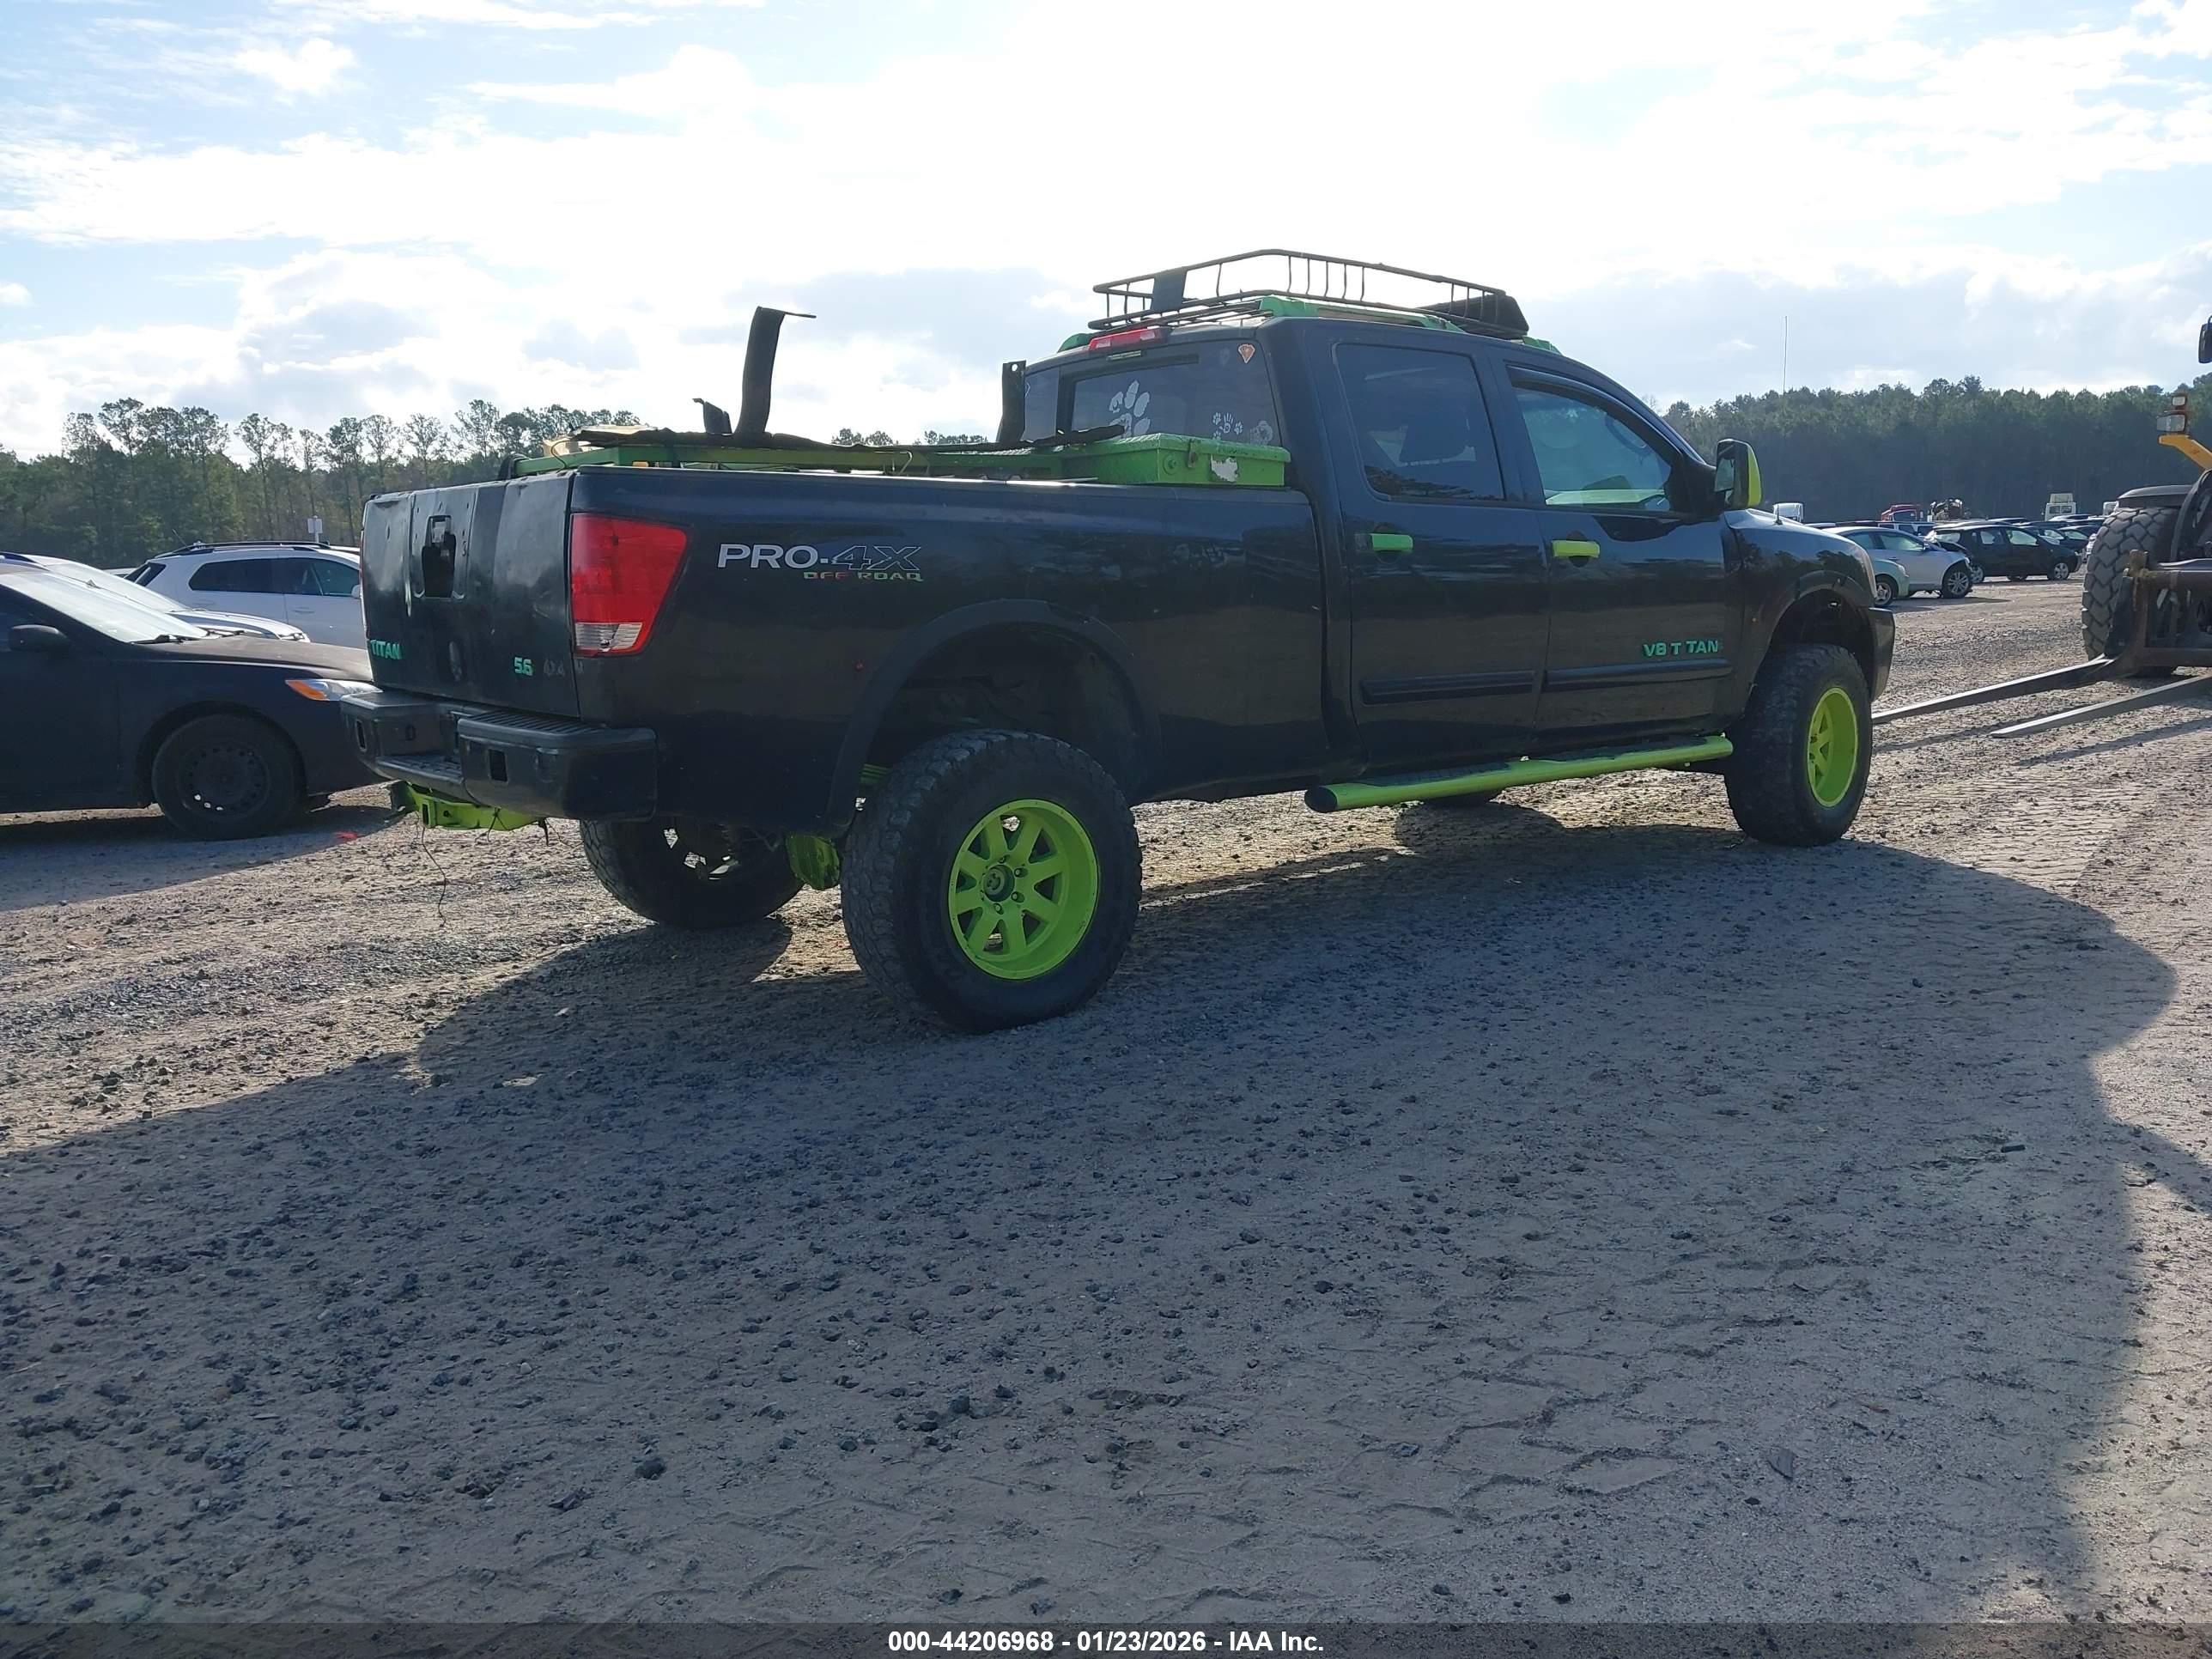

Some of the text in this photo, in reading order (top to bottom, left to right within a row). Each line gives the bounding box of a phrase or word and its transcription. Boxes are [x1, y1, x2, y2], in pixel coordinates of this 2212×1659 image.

[803, 570, 925, 582] OFF ROAD
[370, 639, 403, 660] TITAN
[1643, 642, 1667, 657] V8
